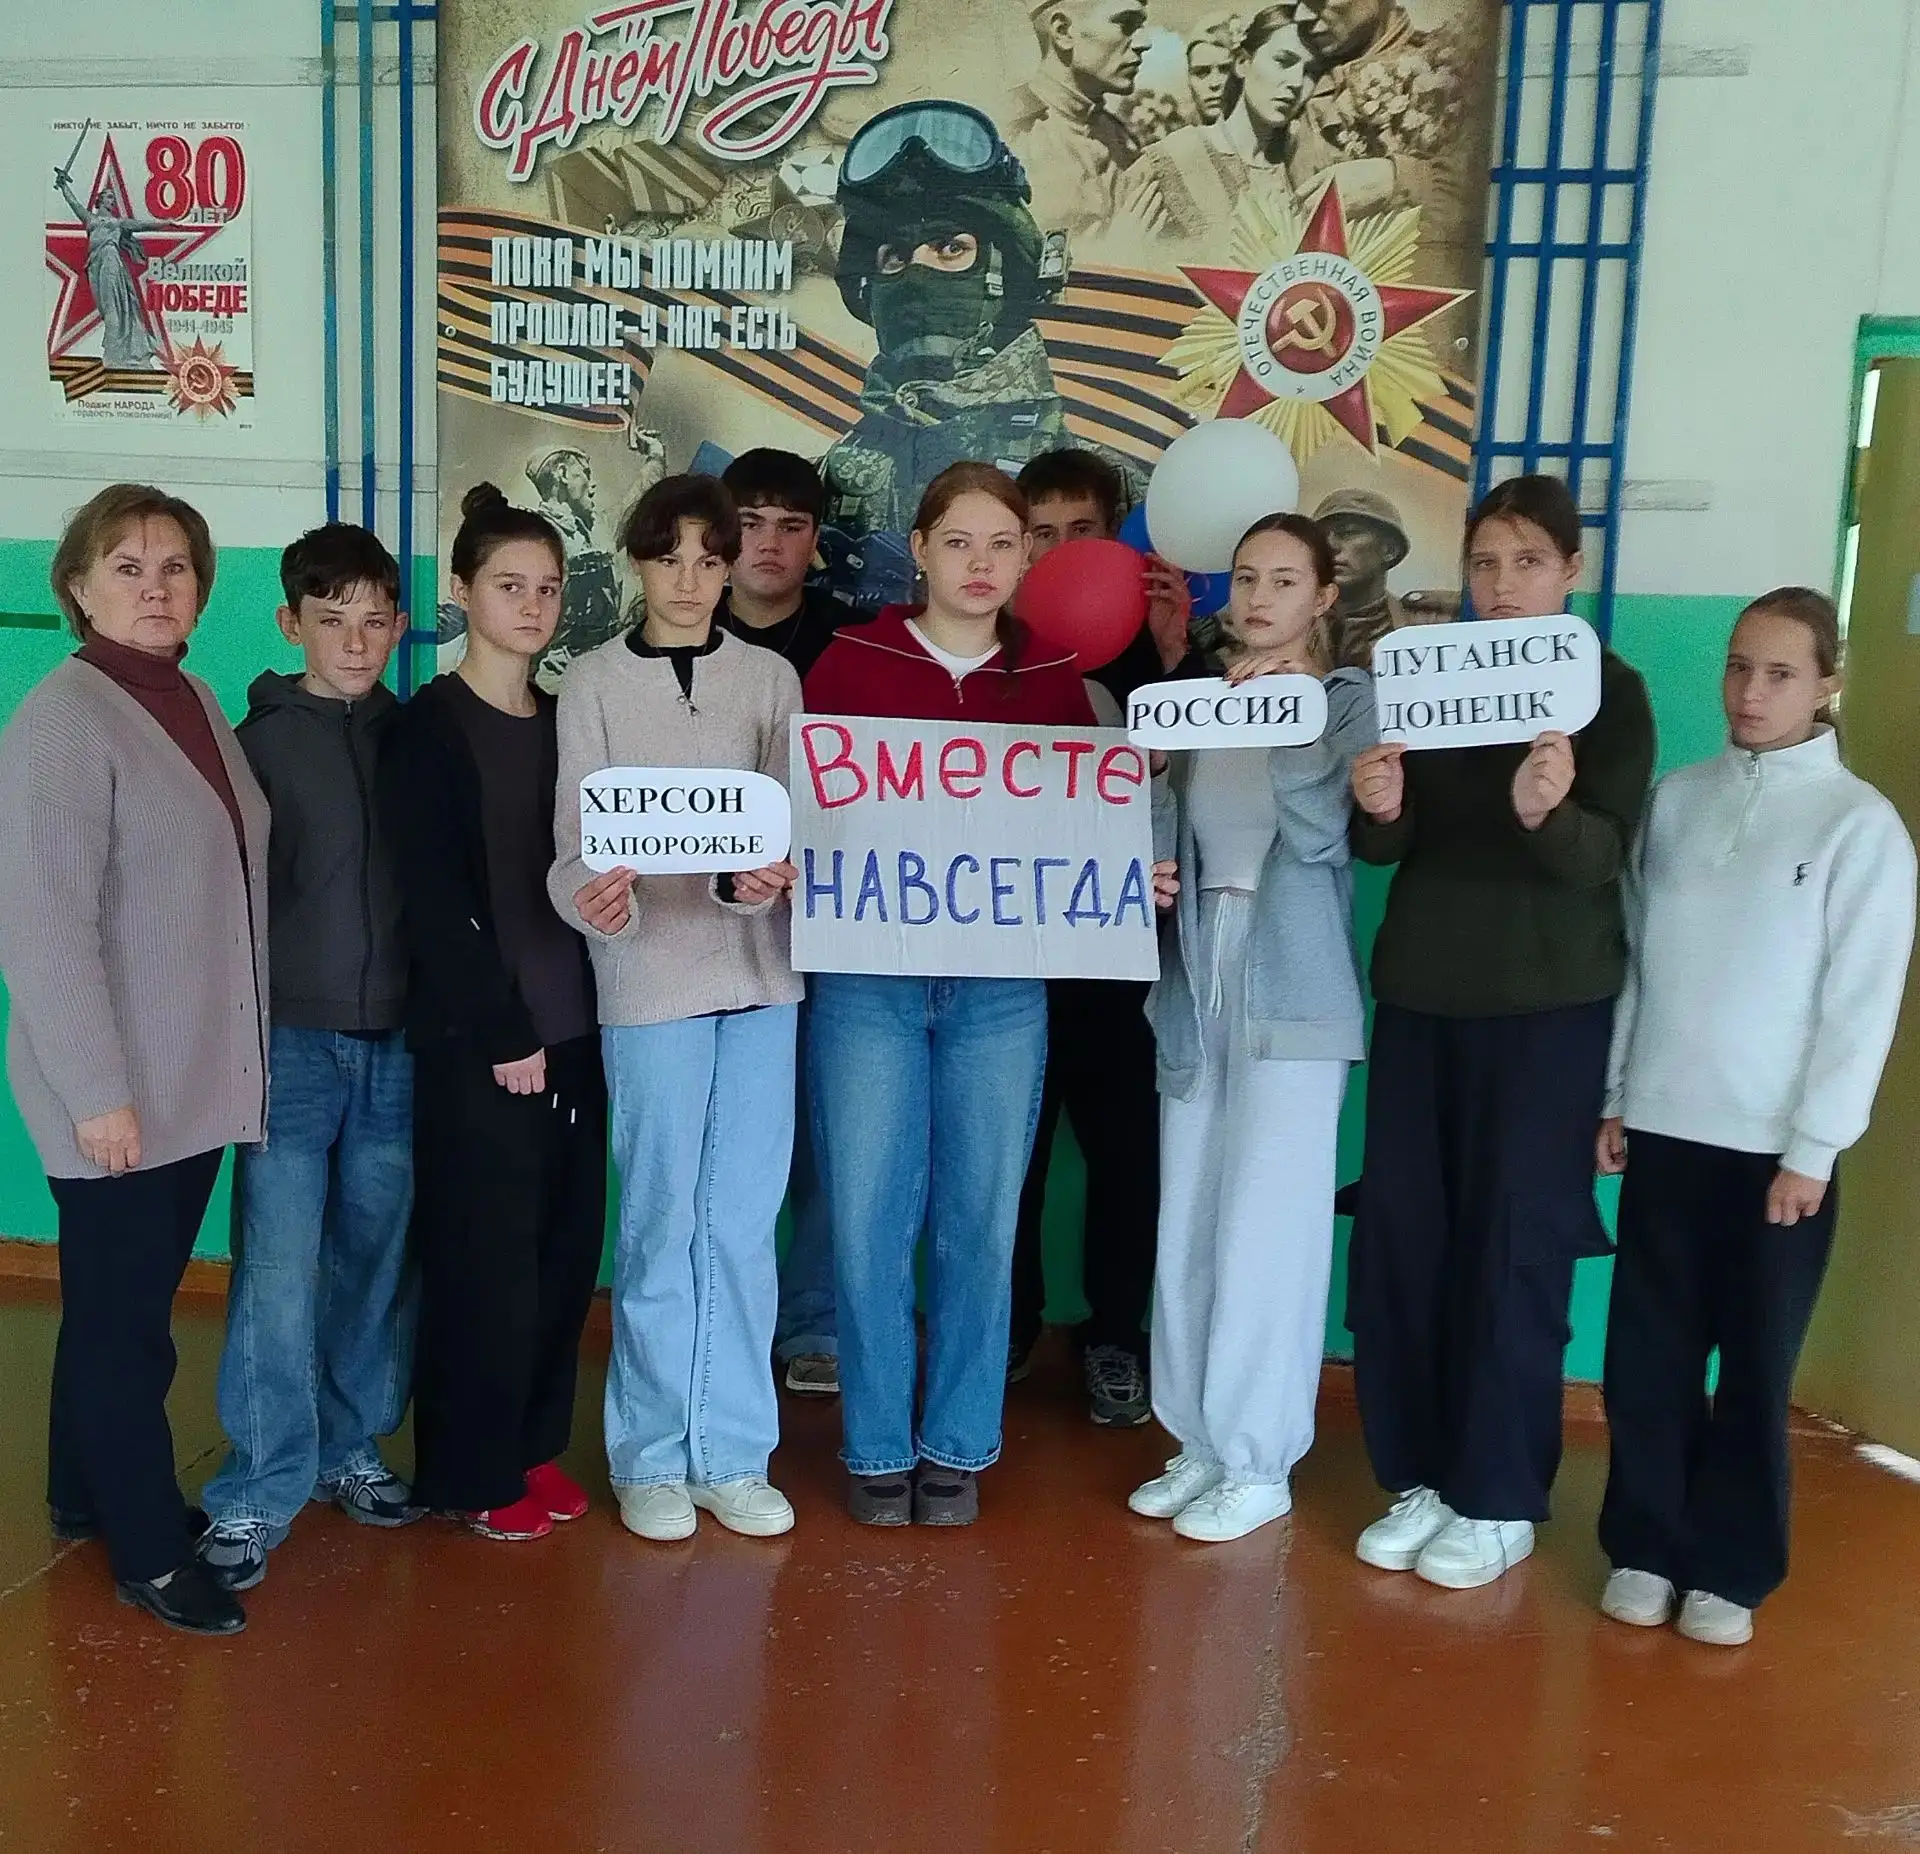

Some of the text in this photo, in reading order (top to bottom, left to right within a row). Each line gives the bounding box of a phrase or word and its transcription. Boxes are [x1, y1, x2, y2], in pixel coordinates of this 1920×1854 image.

[480, 0, 890, 175] С Днём Победы
[53, 120, 244, 131] НИКТО НЕ ЗАБЫТ, НИЧТО НЕ ЗАБЫТО!
[145, 135, 246, 222] 80
[190, 207, 229, 224] ЛЕТ
[491, 237, 793, 291] ПОКА МЫ ПОМНИМ
[146, 283, 248, 319] ПОБЕДЕ
[1244, 258, 1378, 388] ОТЕЧЕСТВЕННАЯ ВОЙНА
[167, 318, 234, 334] 1941-1945
[667, 304, 721, 350] НАС
[731, 306, 797, 351] ЕСТЬ
[77, 399, 112, 410] Подвиг
[114, 400, 155, 411] НАРОДА
[491, 361, 632, 407] БУДУЩЕЕ!
[1376, 631, 1581, 680] ЛУГАНСК
[1130, 694, 1306, 732] РОССИЯ
[1381, 688, 1558, 734] ДОНЕЦК
[801, 722, 1147, 810] Вместе
[582, 786, 746, 815] ХЕРСОН
[583, 834, 765, 856] ЗАПОРОЖЬЕ
[804, 847, 1154, 929] НАВСЕГДА
